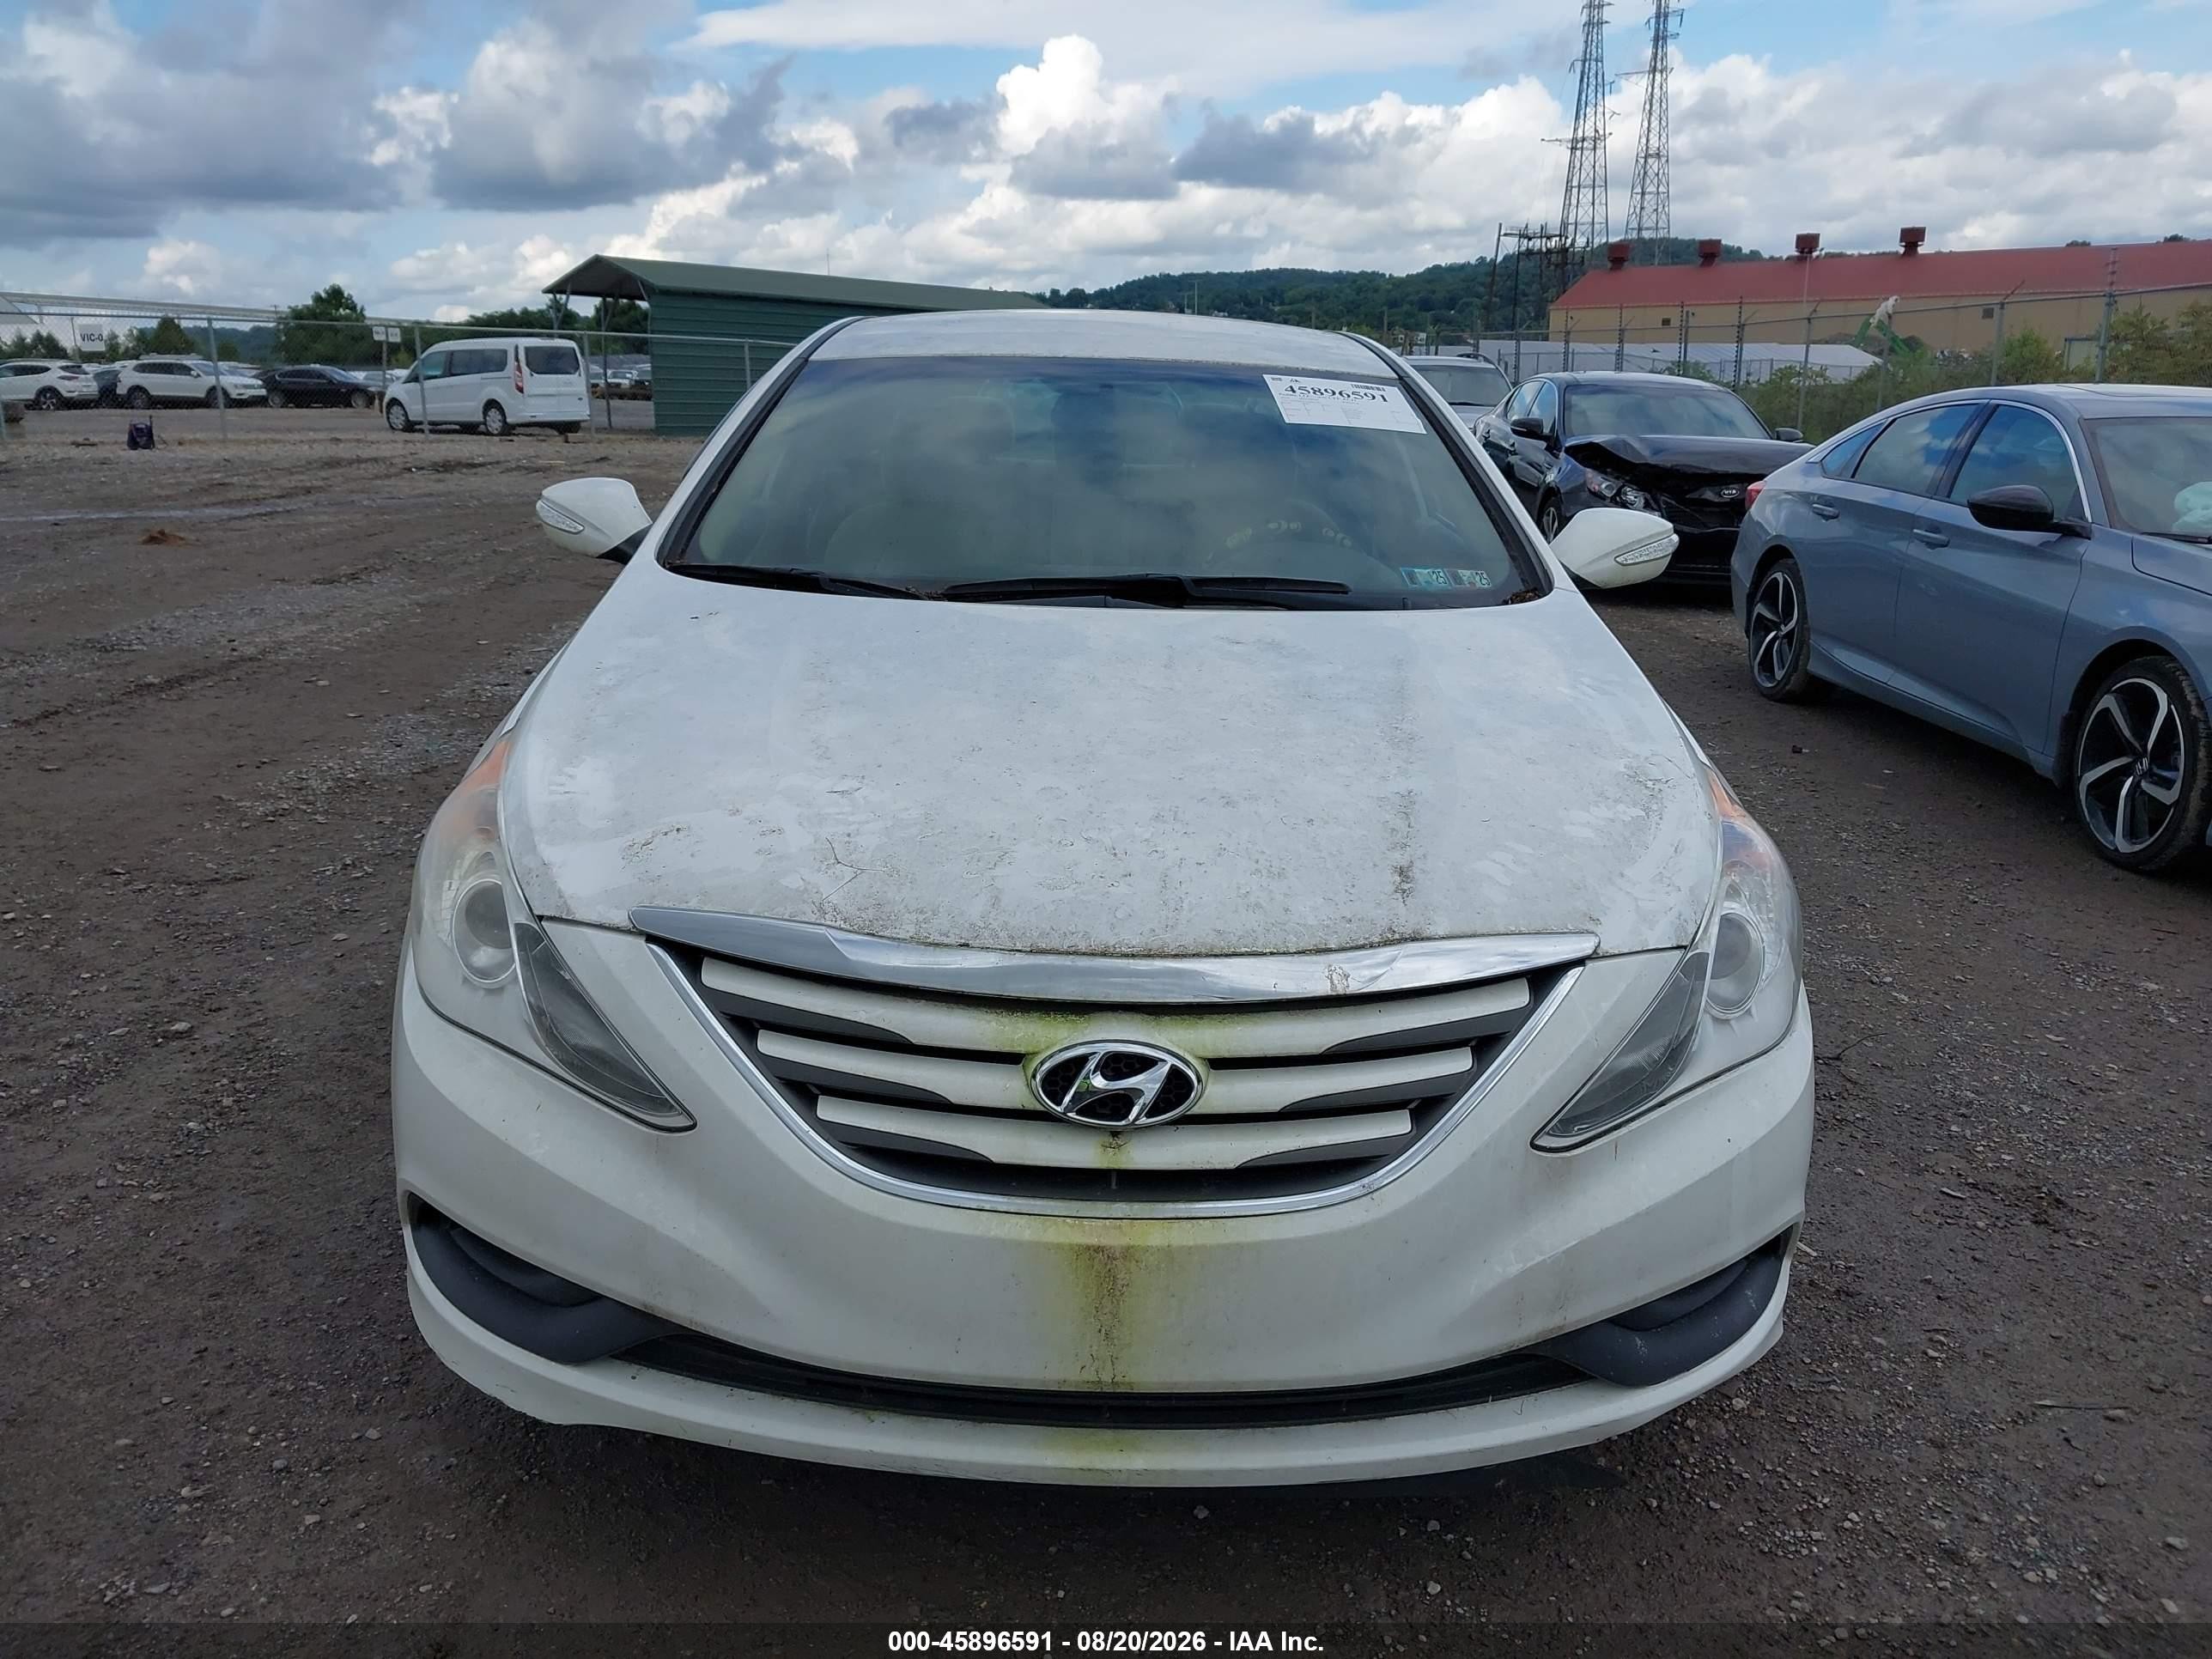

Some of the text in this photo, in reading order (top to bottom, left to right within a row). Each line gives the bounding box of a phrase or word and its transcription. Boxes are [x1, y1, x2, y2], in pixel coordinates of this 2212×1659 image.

[1284, 385, 1389, 403] 45896591
[1431, 570, 1448, 585] 25
[1475, 572, 1491, 586] 25
